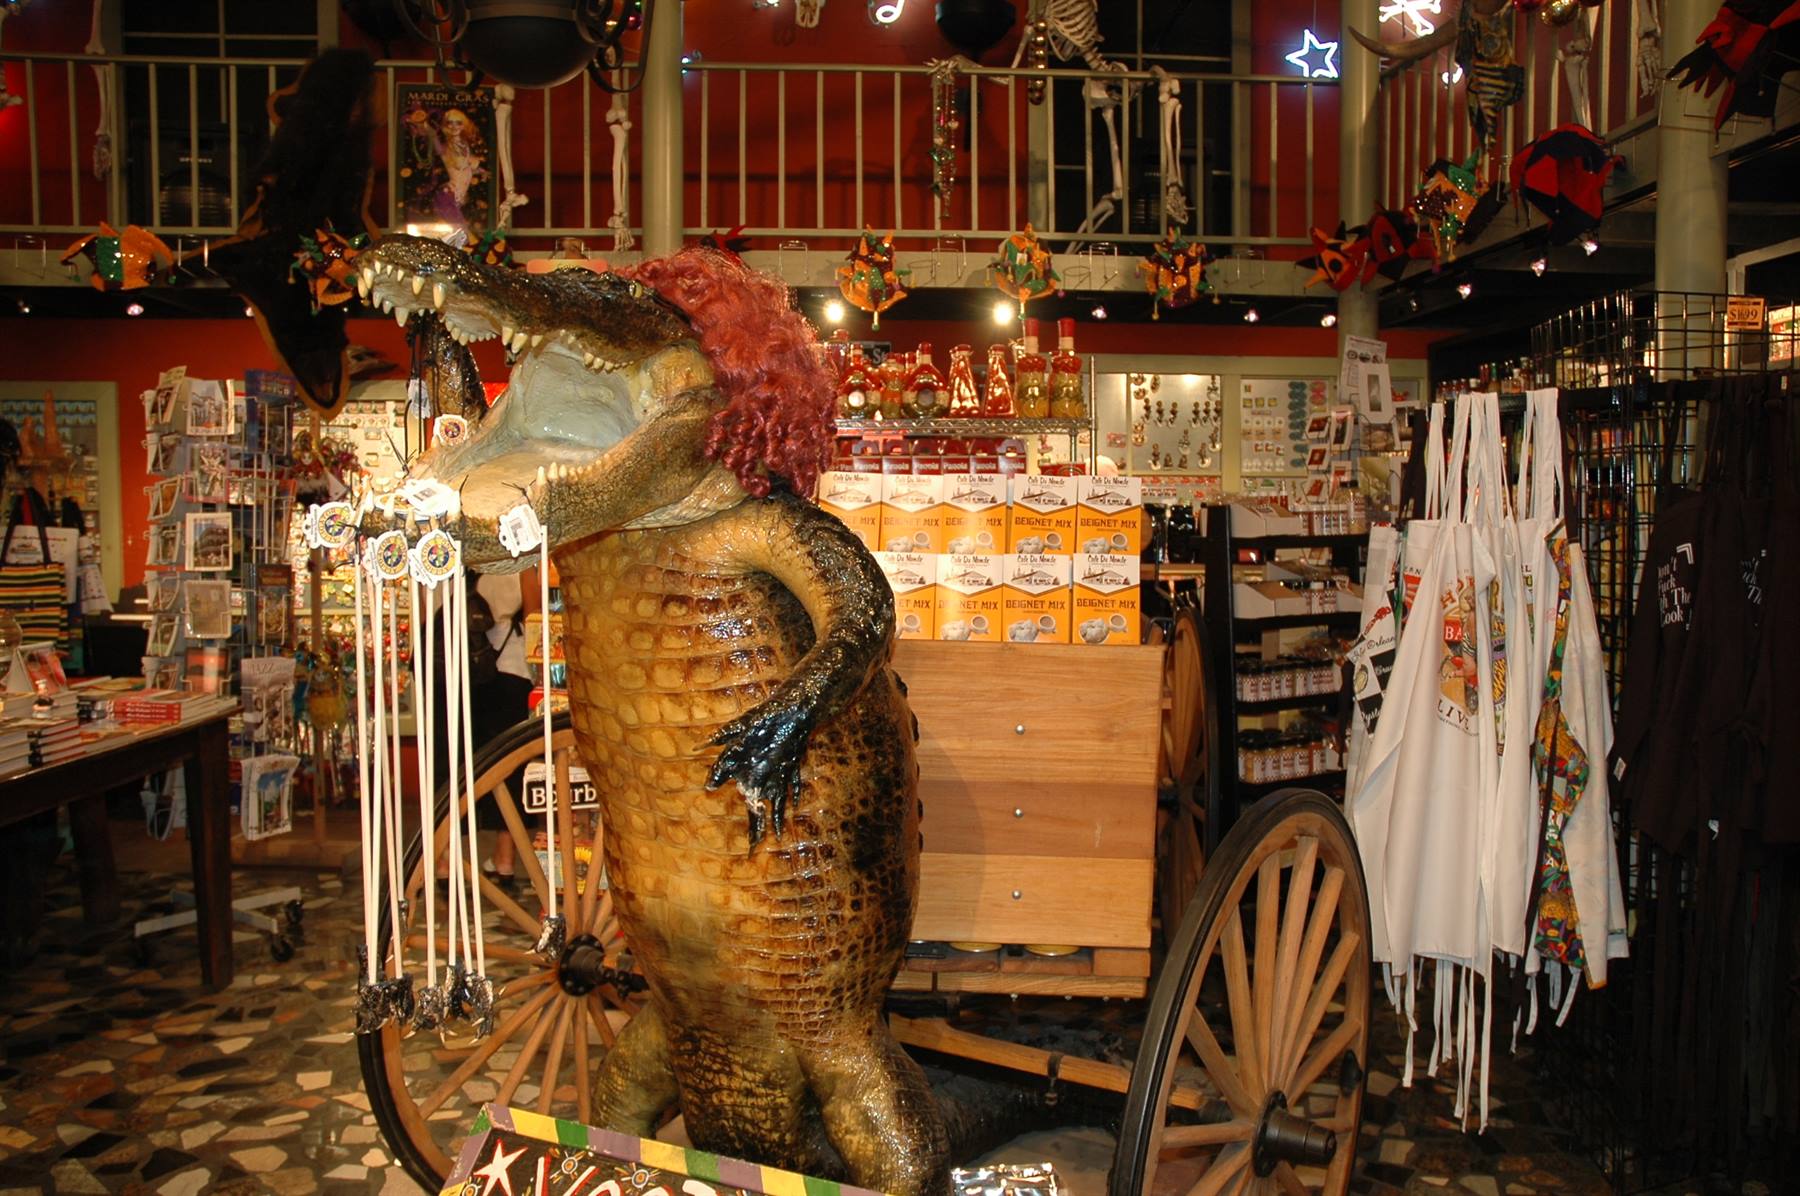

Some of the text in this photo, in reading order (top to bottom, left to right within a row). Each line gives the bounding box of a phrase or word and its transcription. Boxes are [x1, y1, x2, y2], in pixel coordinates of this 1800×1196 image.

[407, 92, 490, 103] MARDI GRAS
[923, 518, 940, 528] MIX
[986, 518, 1003, 528] MIX
[1014, 516, 1073, 529] BEIGNET MIX
[1079, 517, 1137, 529] BEIGNET MIX
[913, 599, 931, 609] MIX
[980, 600, 999, 610] MIX
[1005, 599, 1066, 610] BEIGNET MIX
[1076, 598, 1137, 609] BEIGNET MIX
